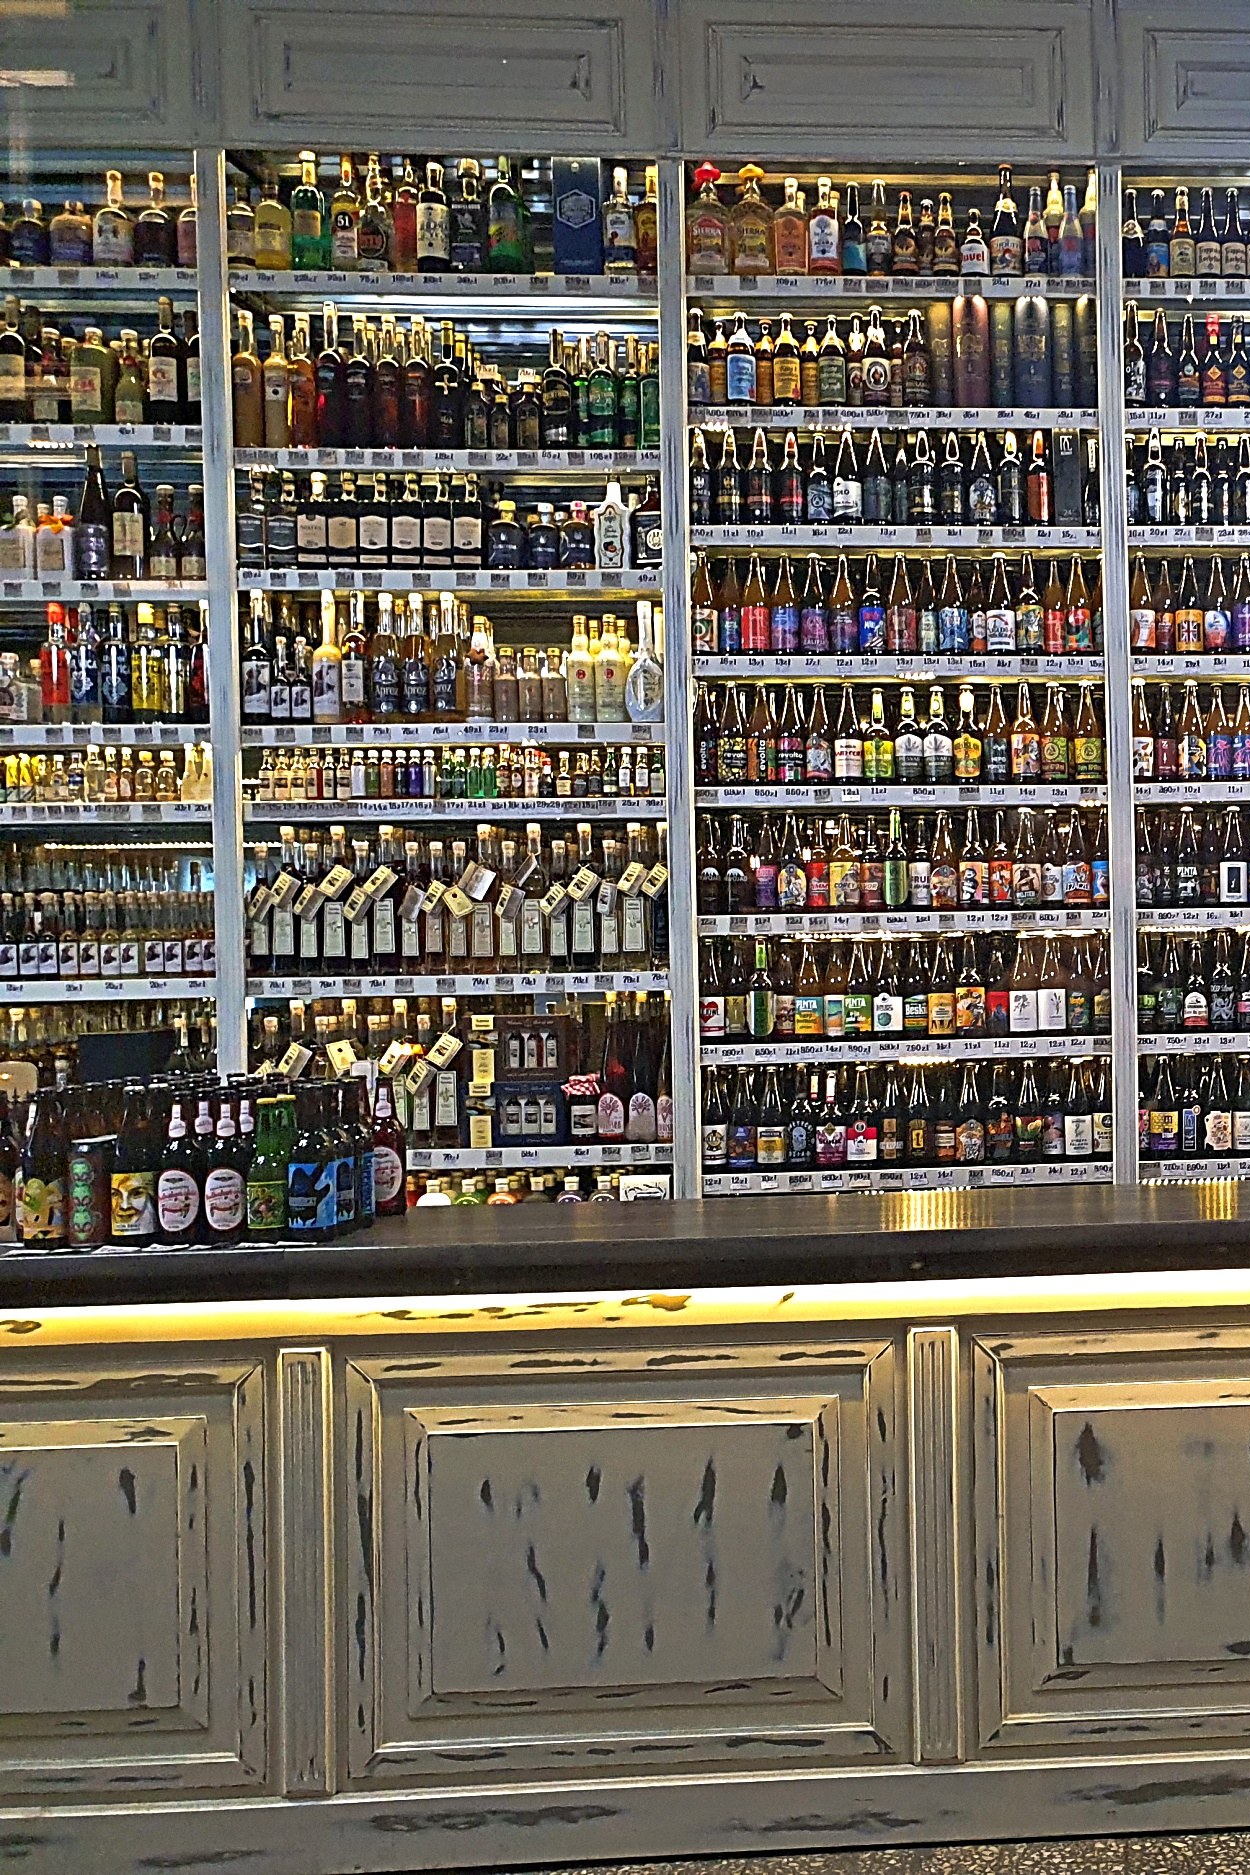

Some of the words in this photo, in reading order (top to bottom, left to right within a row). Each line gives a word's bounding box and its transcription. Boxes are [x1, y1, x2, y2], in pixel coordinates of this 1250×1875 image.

[337, 215, 350, 227] 51
[963, 250, 985, 262] uvel
[1176, 866, 1198, 876] PINTA
[796, 1000, 818, 1010] PINTA
[845, 998, 866, 1007] PINTA
